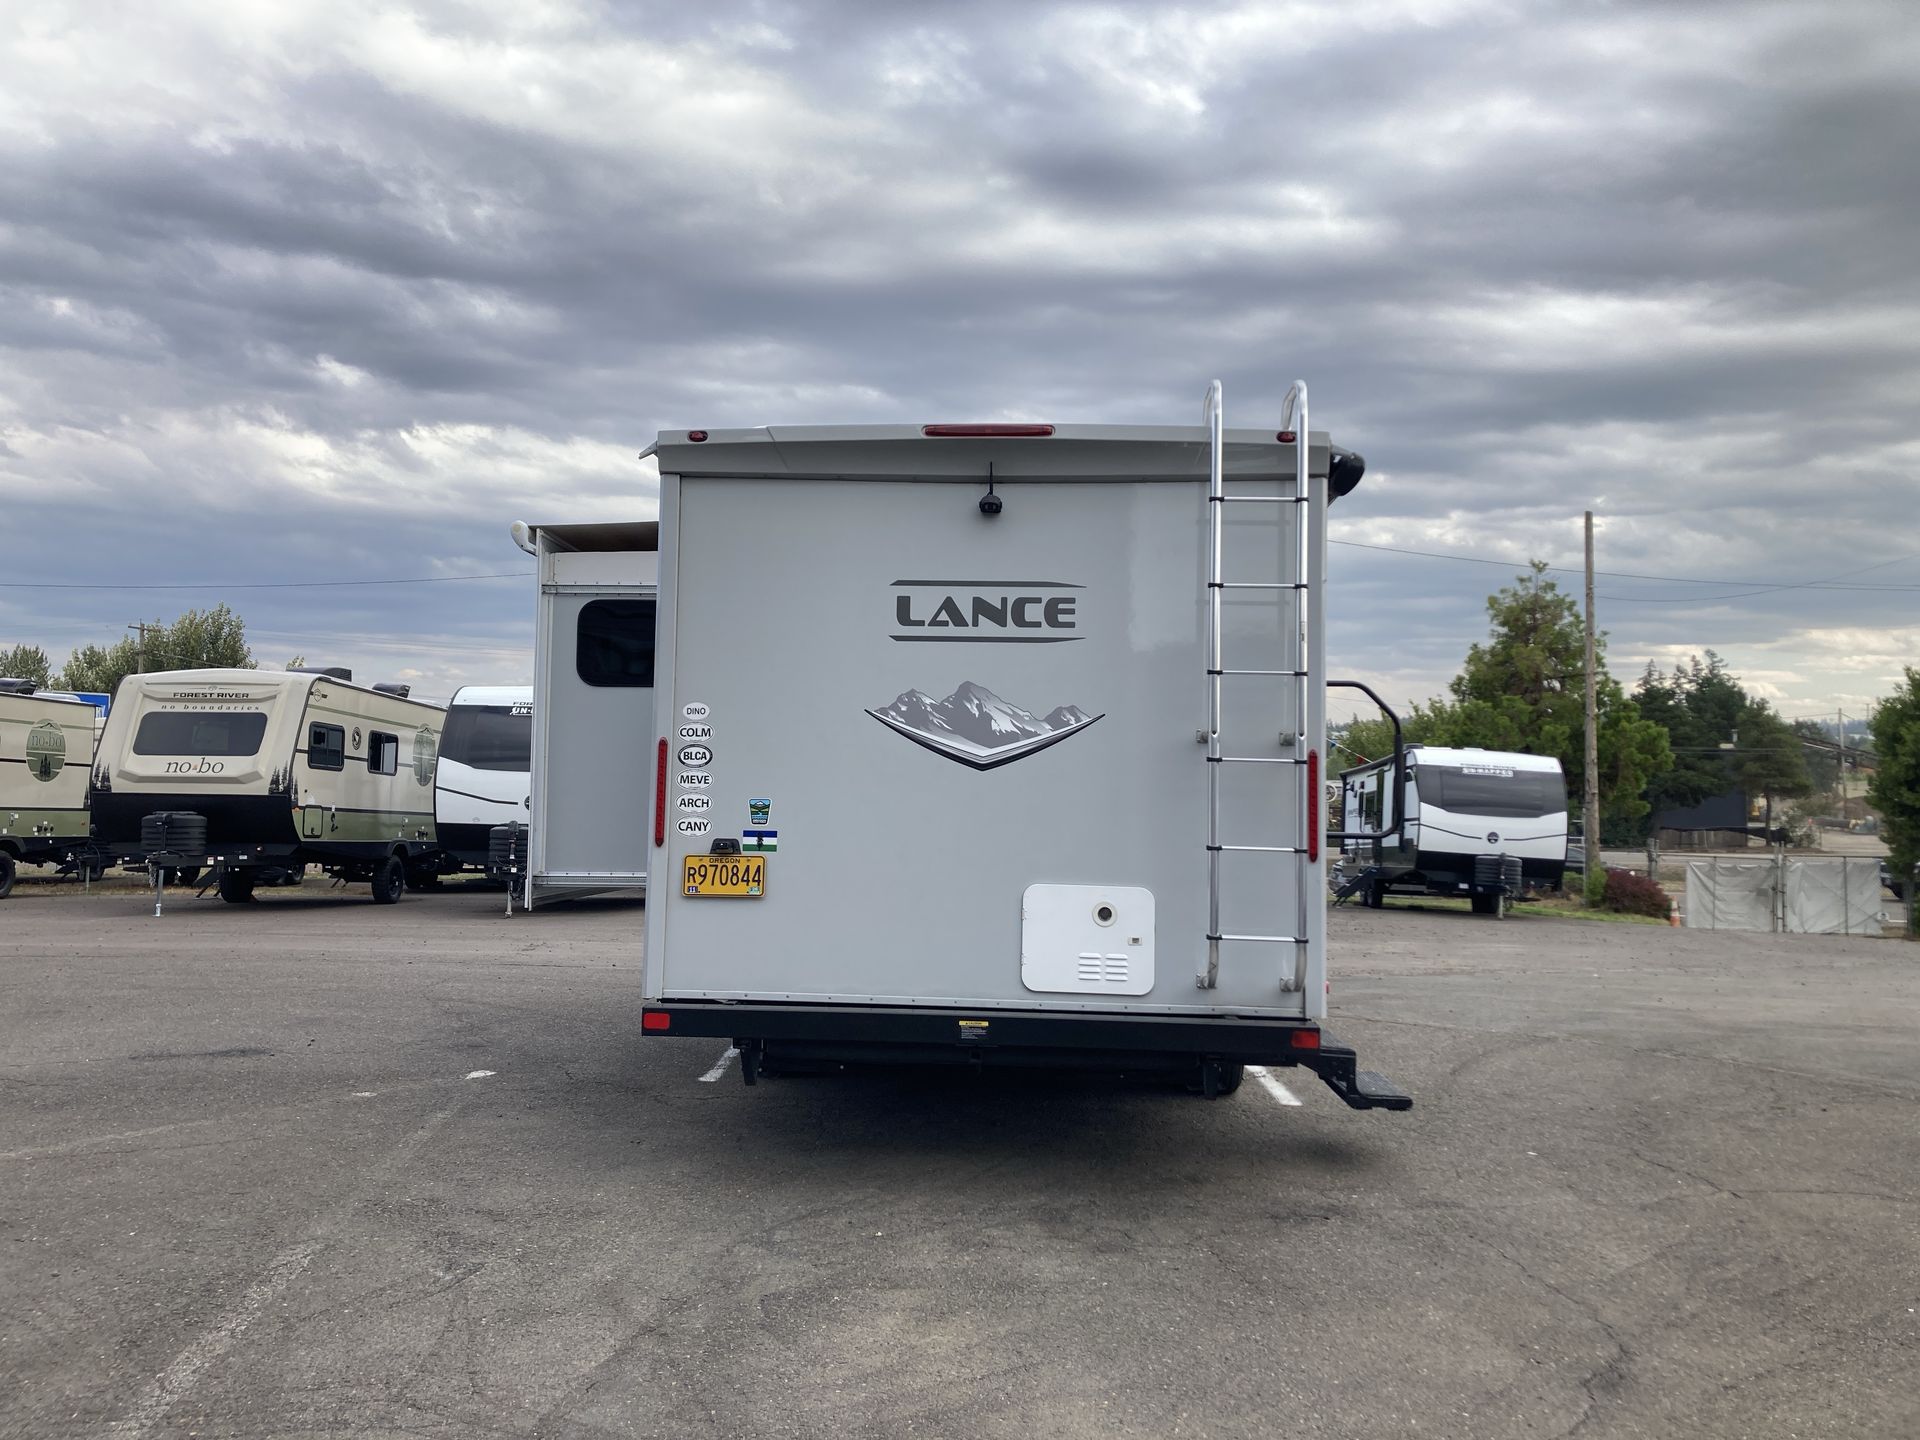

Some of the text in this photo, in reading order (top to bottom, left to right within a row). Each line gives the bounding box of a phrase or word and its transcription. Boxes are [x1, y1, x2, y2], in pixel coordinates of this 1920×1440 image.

[896, 595, 1076, 628] LANCE
[686, 707, 706, 715] DINO
[680, 727, 711, 737] COLM
[683, 751, 707, 761] BLCA
[680, 775, 710, 784] MEVE
[679, 798, 709, 808] ARCH
[678, 821, 709, 831] CANY
[687, 864, 762, 886] R970844
